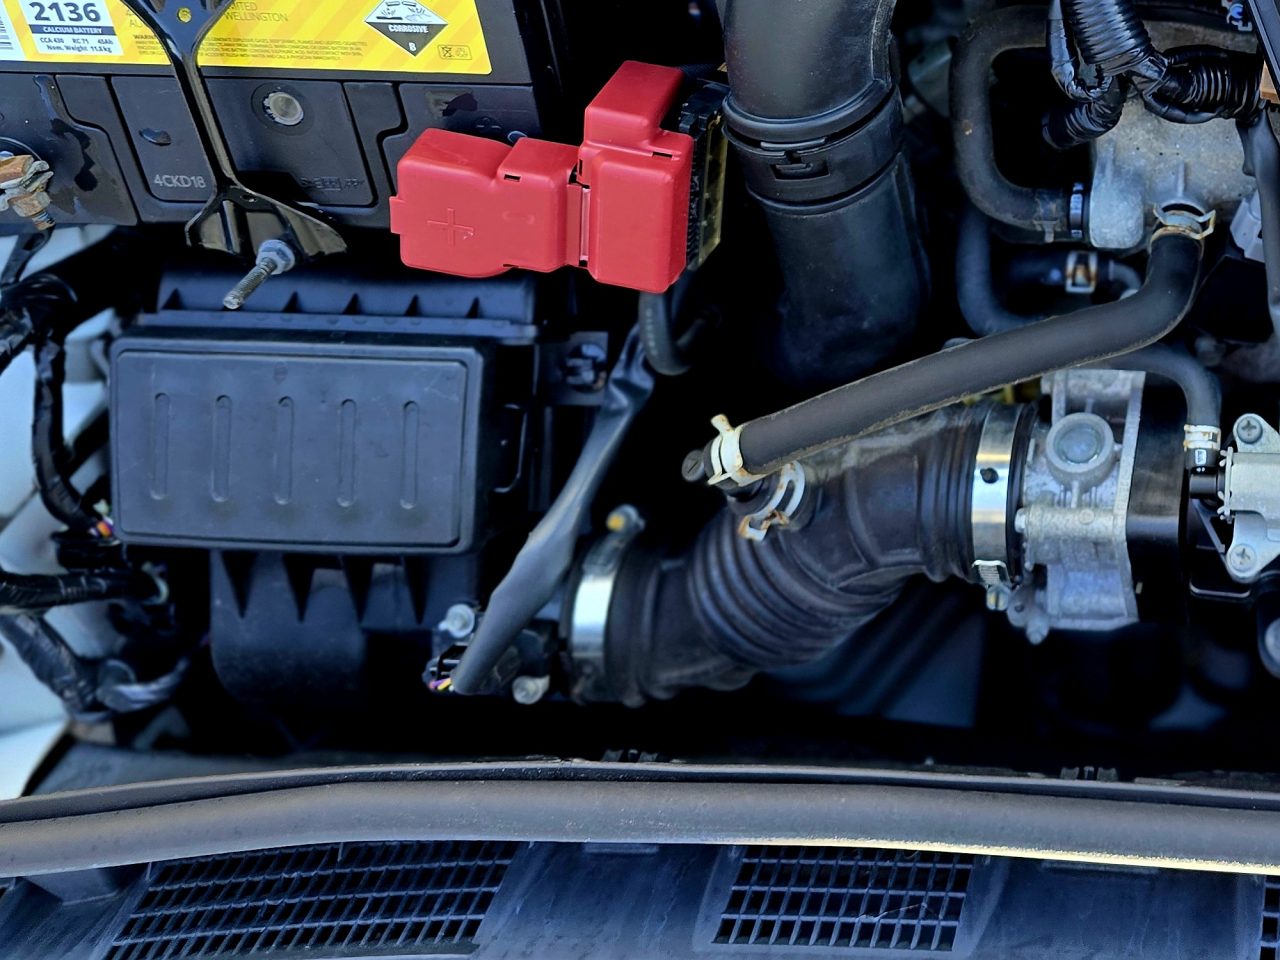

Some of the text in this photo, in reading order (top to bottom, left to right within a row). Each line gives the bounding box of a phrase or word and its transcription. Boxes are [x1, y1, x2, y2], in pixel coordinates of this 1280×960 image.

[29, 1, 102, 22] 2136
[225, 12, 289, 22] WELLINGTON
[43, 26, 103, 35] CALCIUM BATTERY
[388, 24, 429, 33] CORROSIVE
